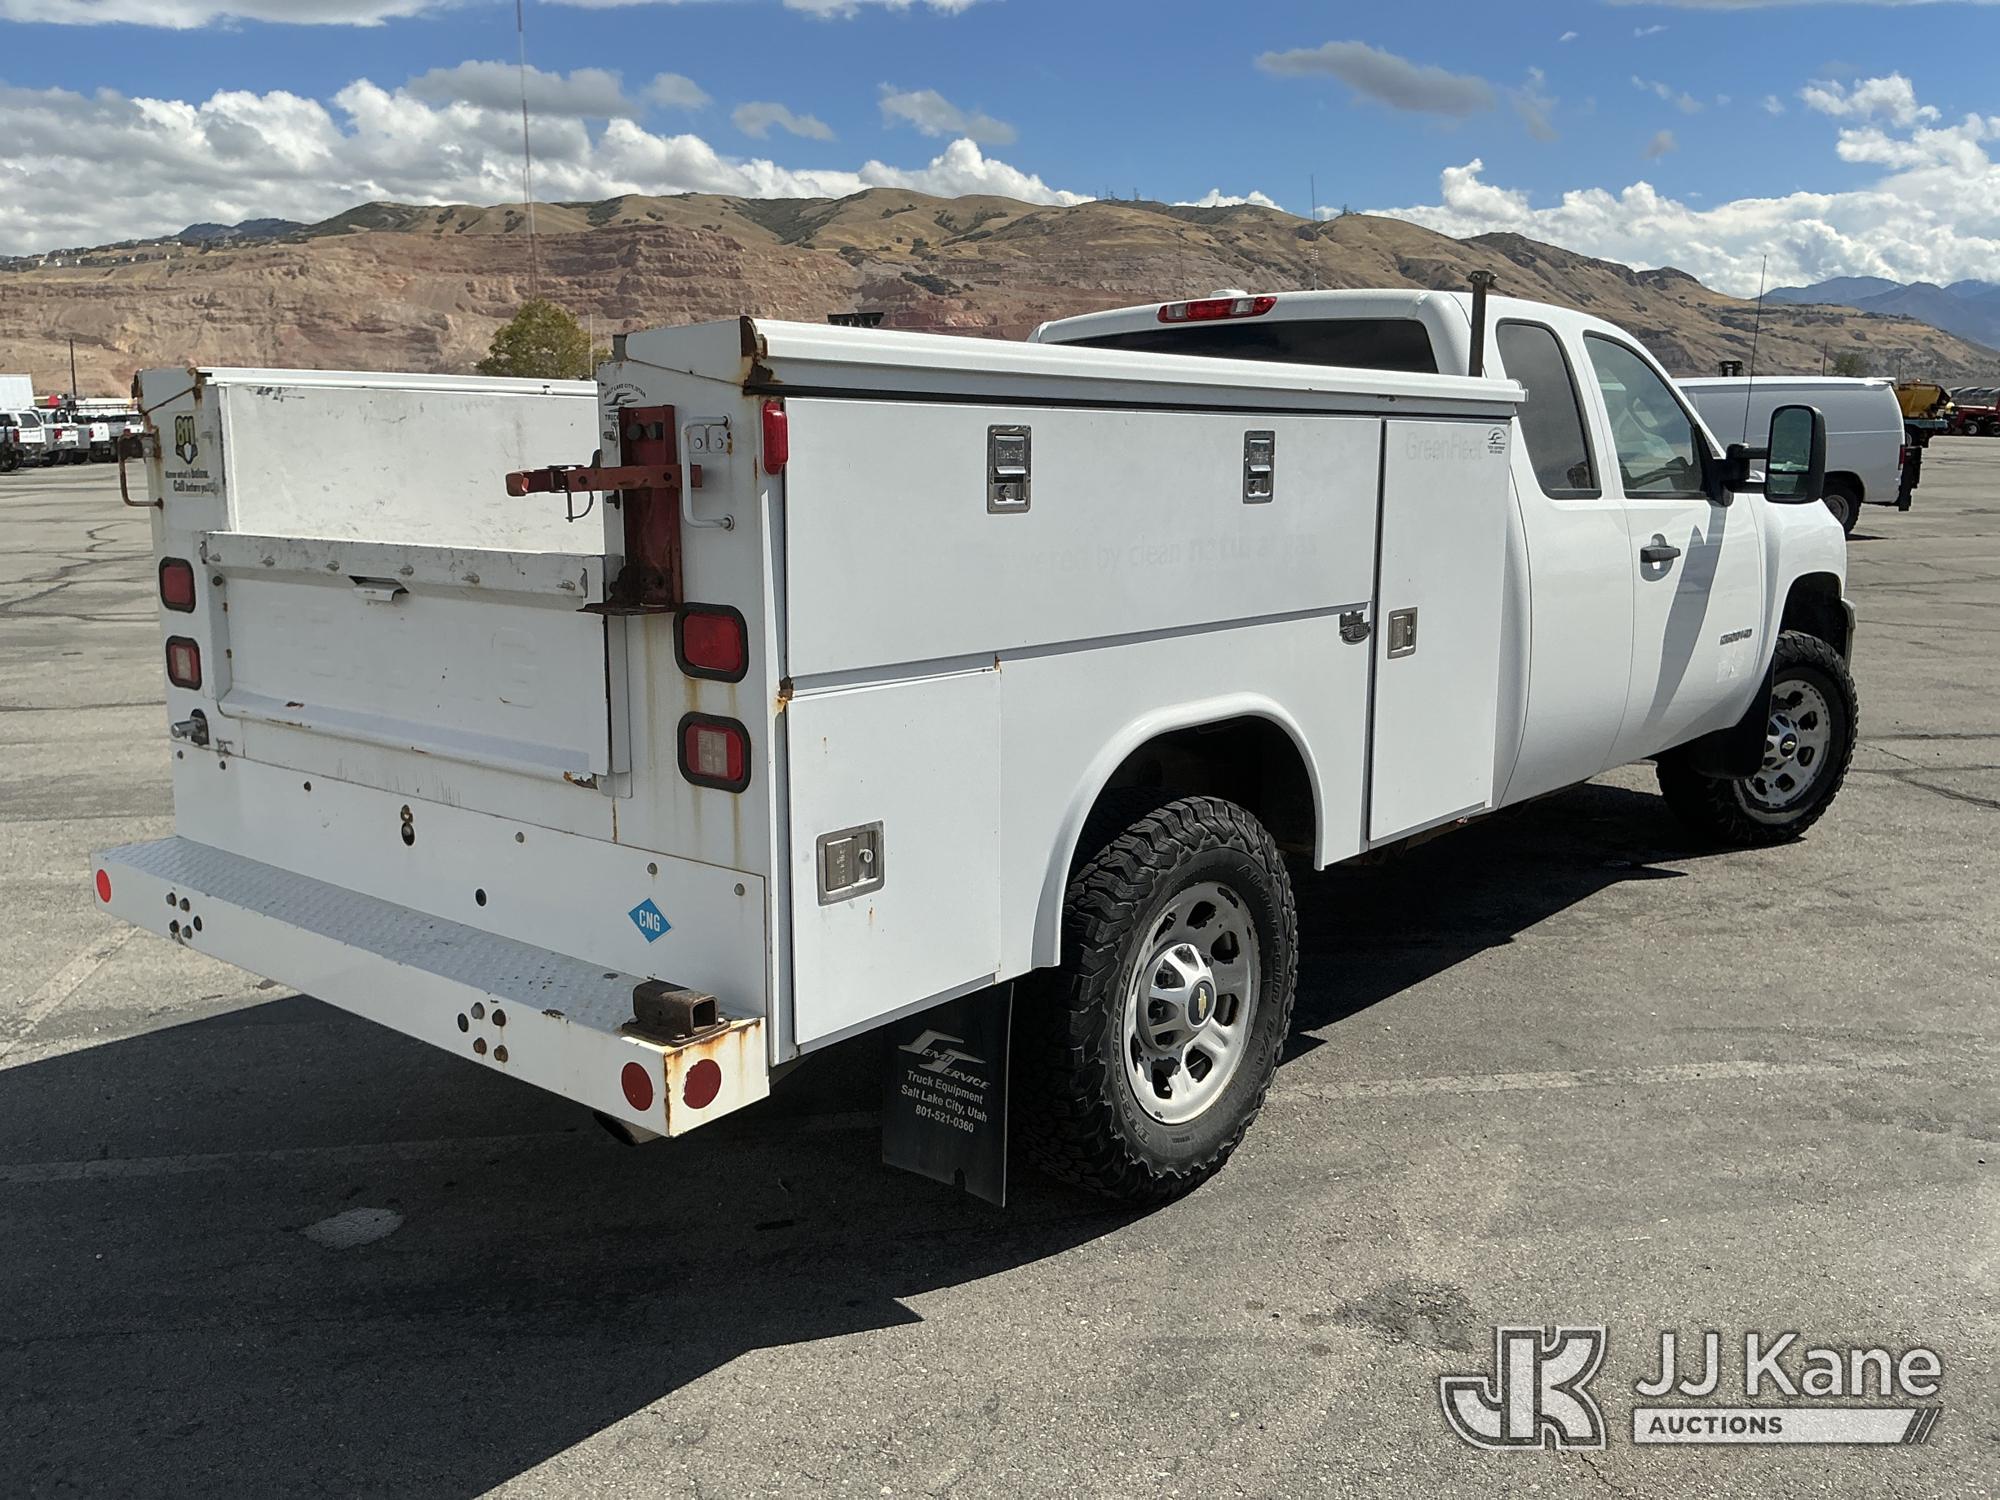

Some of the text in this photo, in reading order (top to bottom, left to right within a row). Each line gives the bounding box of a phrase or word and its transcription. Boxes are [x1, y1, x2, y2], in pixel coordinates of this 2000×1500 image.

[175, 416, 195, 446] 811
[639, 909, 660, 932] CNG
[907, 1070, 983, 1104] Truck Equipment
[901, 1084, 988, 1123] Salt Lake City, Utah
[915, 1104, 974, 1133] 801-521-0360
